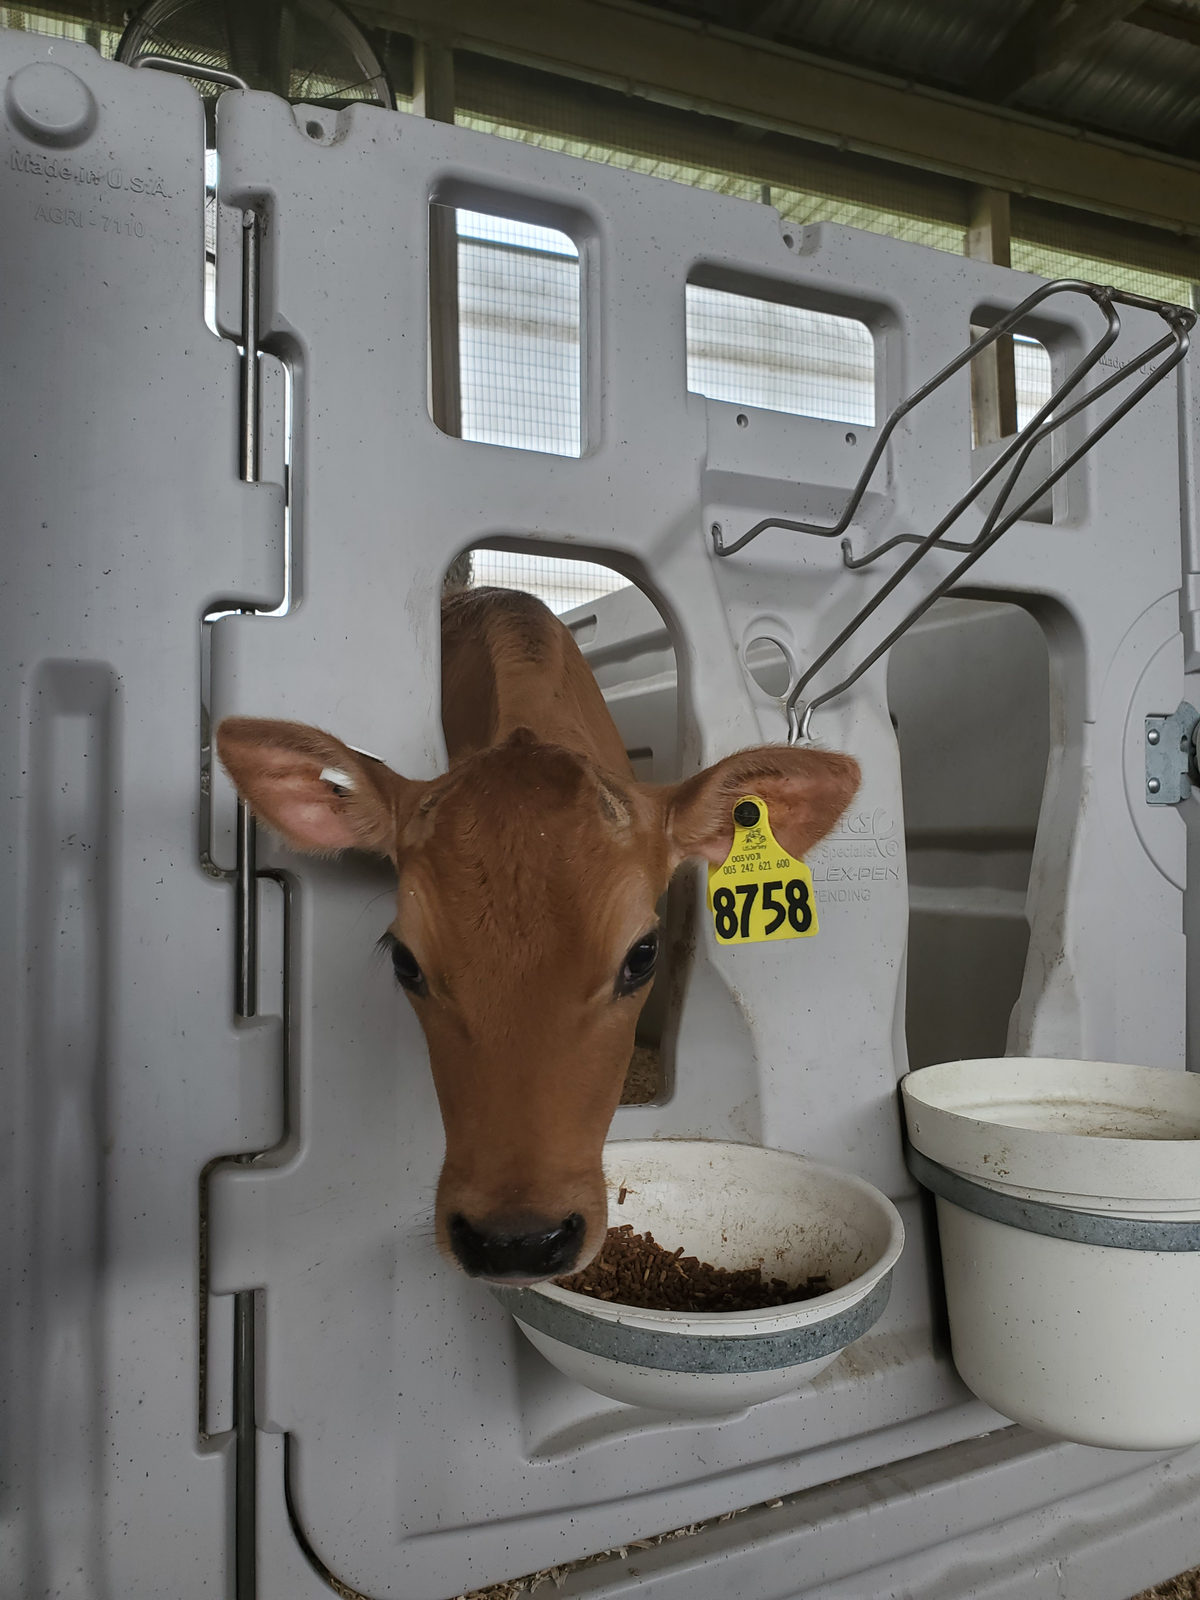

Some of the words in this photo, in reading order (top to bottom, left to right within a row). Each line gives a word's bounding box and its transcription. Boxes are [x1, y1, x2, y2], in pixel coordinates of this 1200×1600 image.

[11, 152, 71, 180] Made
[107, 169, 173, 198] U.S.A.
[34, 206, 84, 228] AGRI
[723, 865, 737, 875] 003
[741, 863, 754, 873] 242
[758, 861, 772, 871] 621
[776, 859, 790, 869] 600
[812, 865, 899, 881] LEX-PEN
[713, 879, 812, 939] 8758
